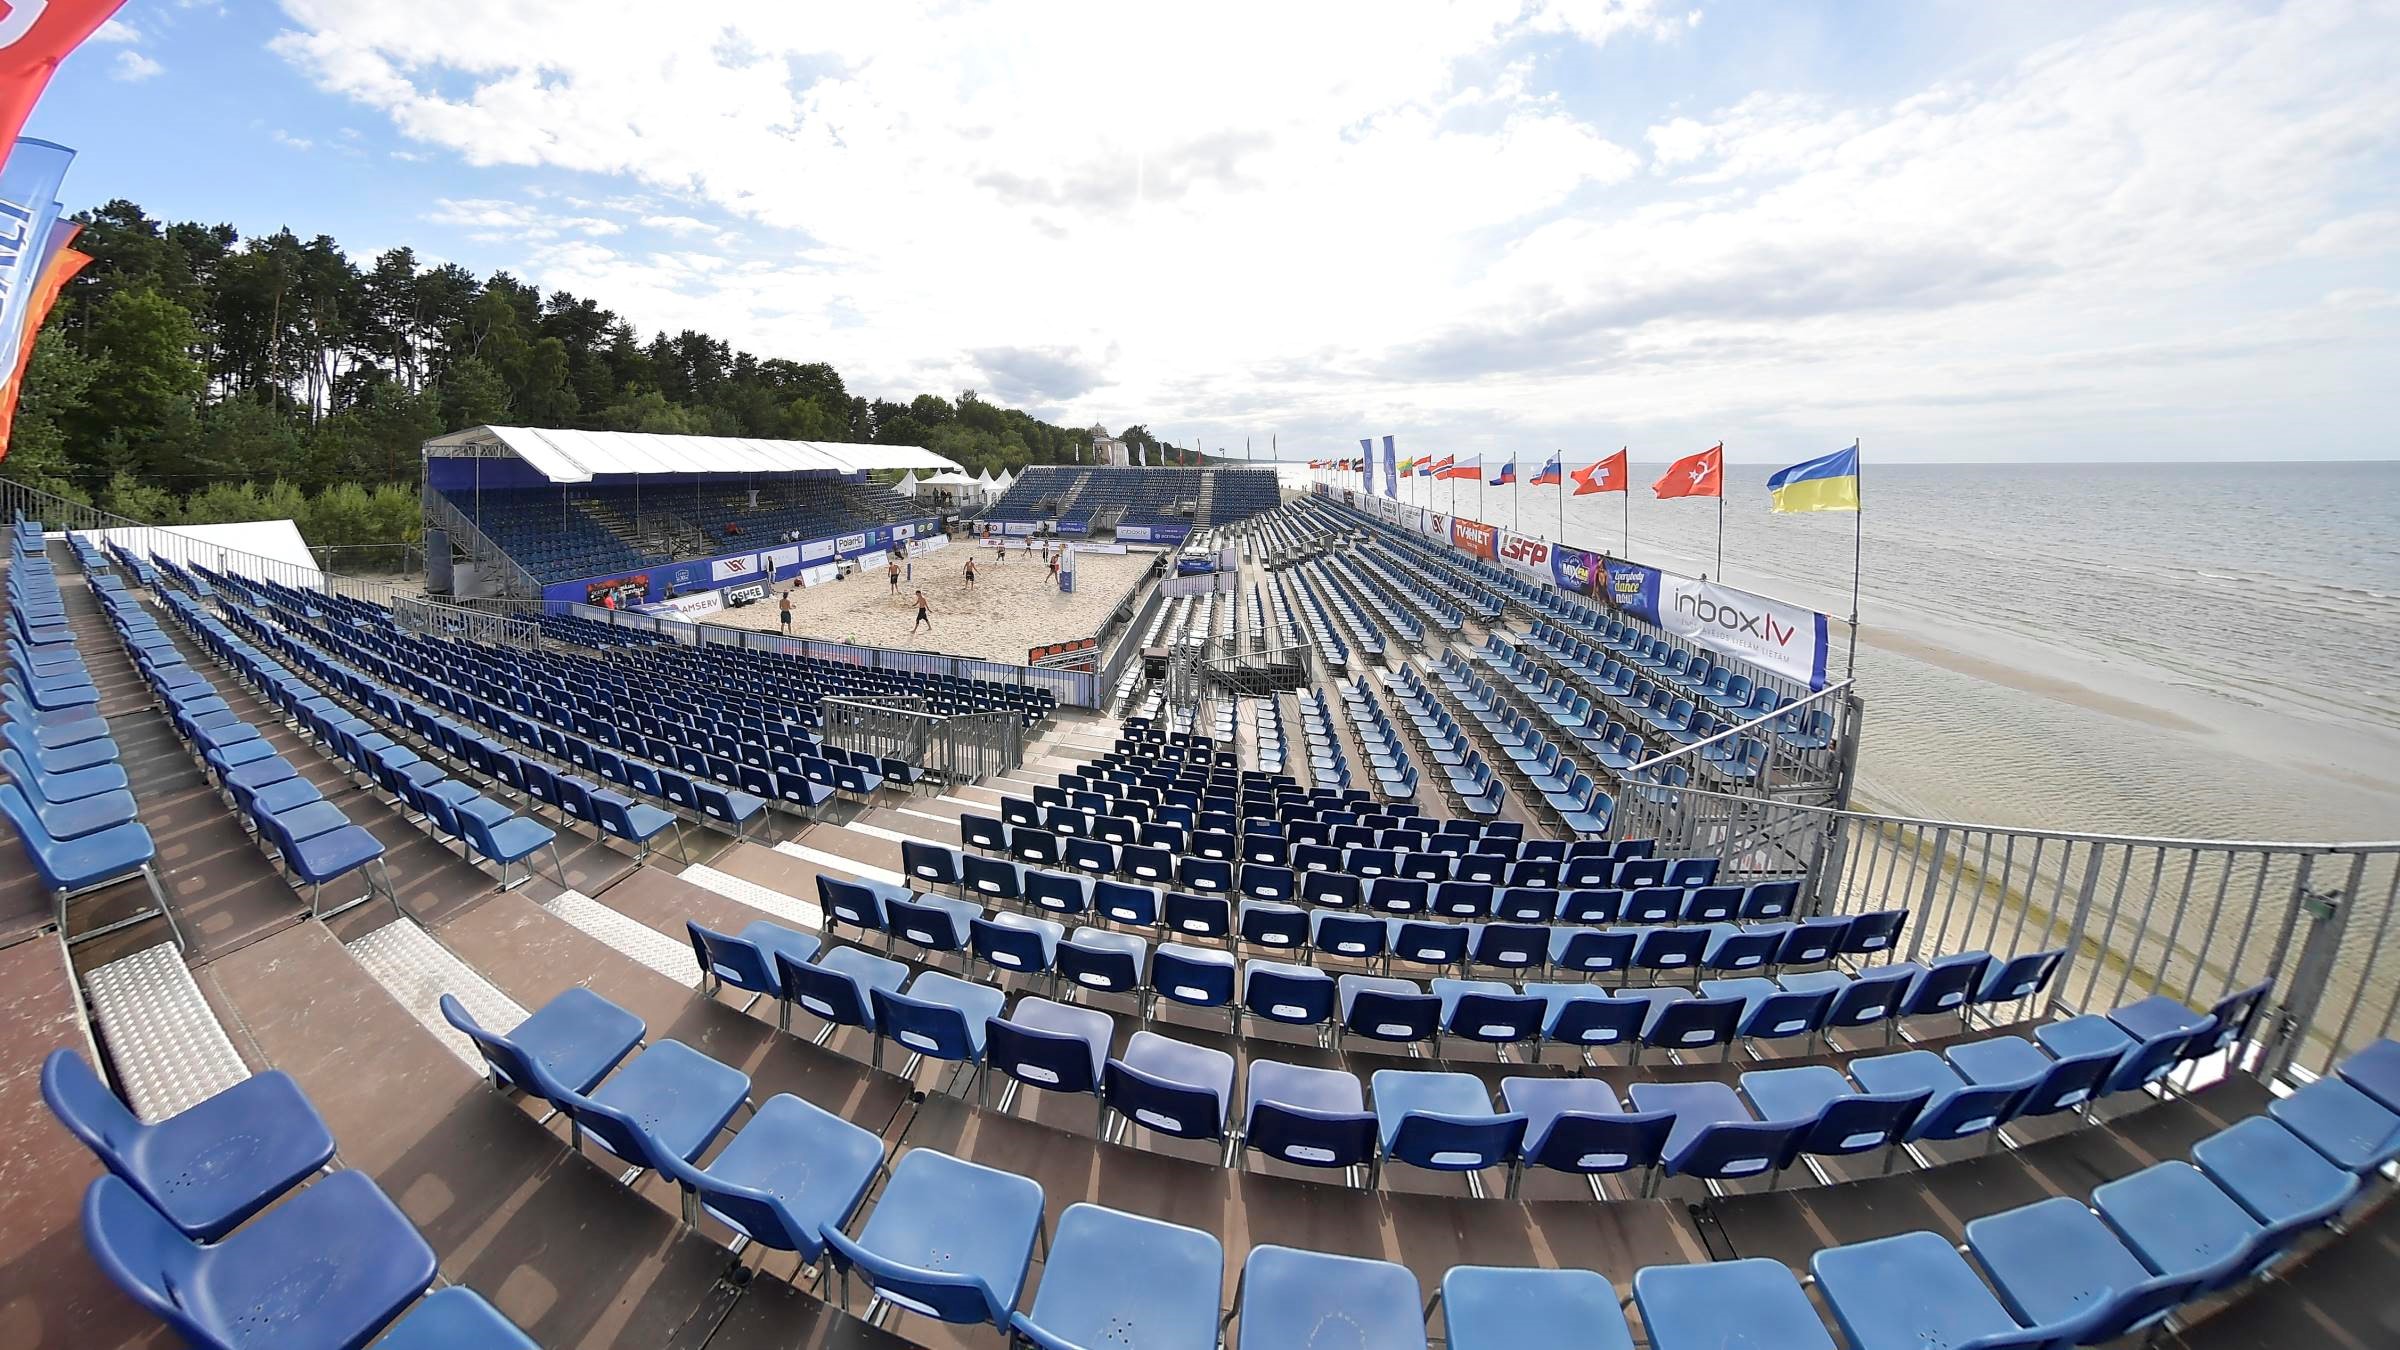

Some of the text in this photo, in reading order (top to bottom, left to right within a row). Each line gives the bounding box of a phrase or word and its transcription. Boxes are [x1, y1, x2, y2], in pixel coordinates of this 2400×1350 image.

[838, 535, 864, 548] PolarHD
[1500, 534, 1548, 567] LSFP
[1614, 570, 1645, 583] Everybody
[1614, 580, 1640, 593] dance
[730, 587, 762, 602] OSHEE
[1615, 593, 1633, 605] now
[681, 598, 718, 614] AMSERV
[1674, 587, 1795, 647] inbox.lv
